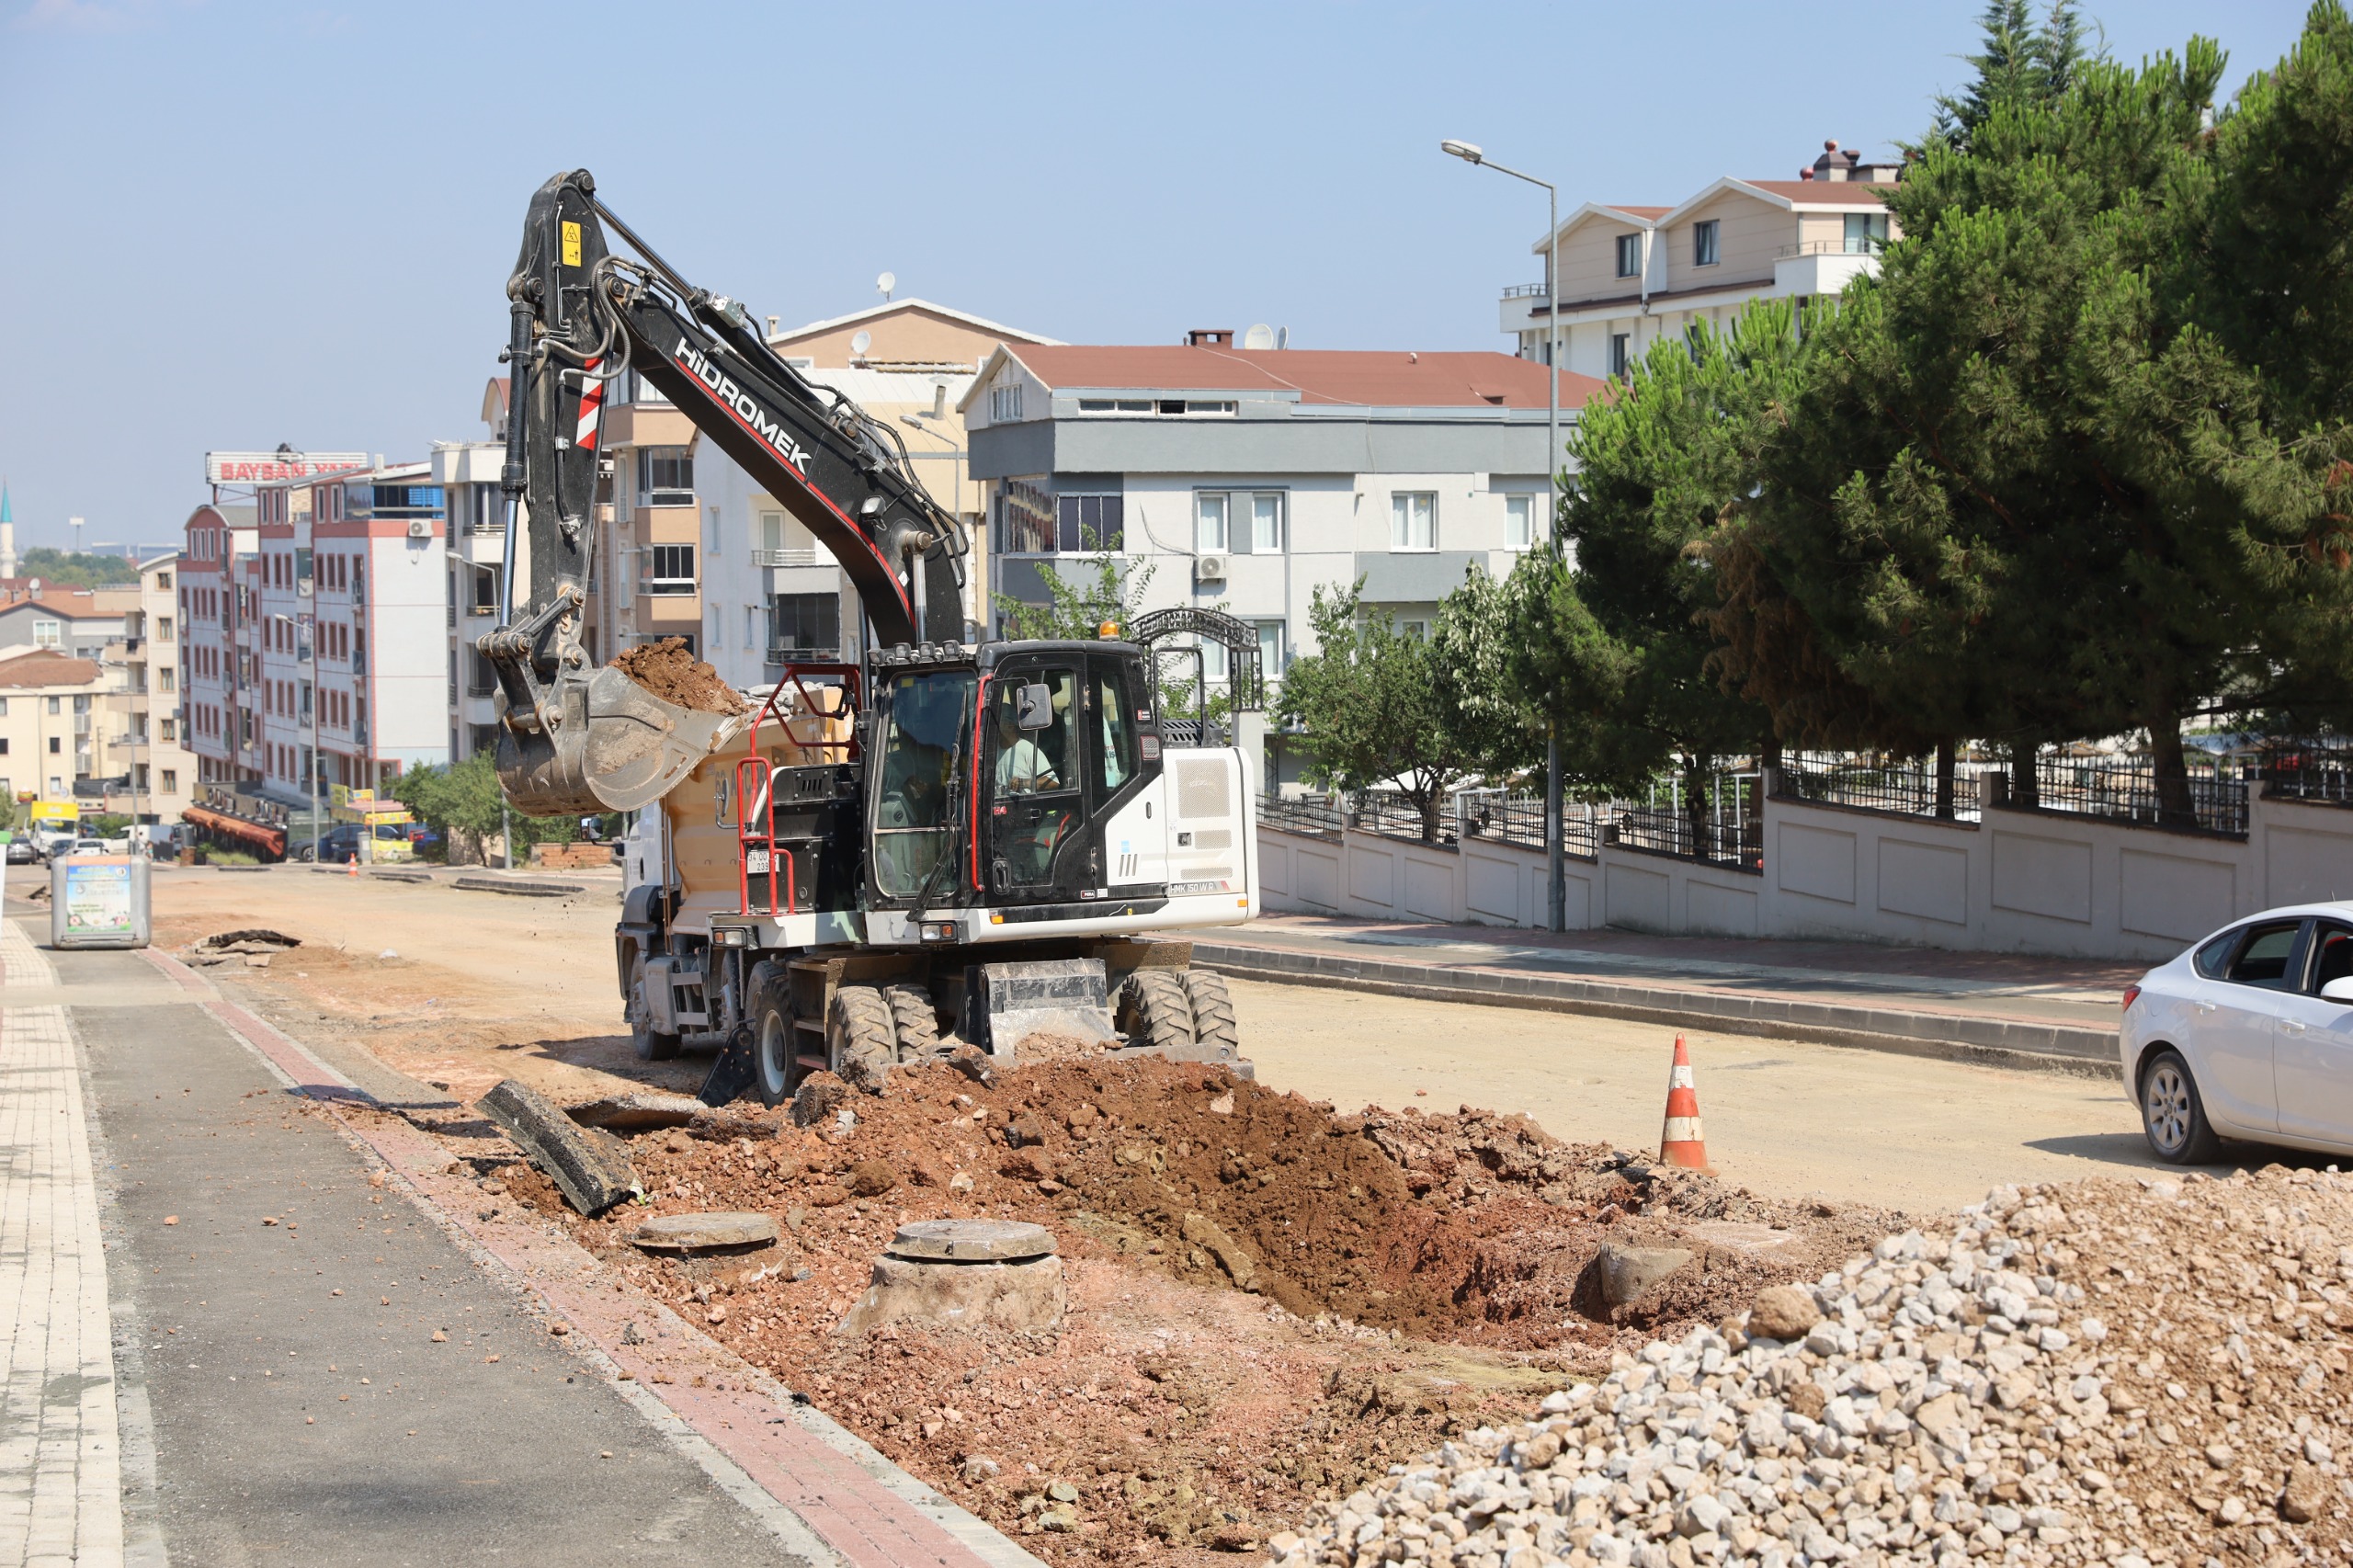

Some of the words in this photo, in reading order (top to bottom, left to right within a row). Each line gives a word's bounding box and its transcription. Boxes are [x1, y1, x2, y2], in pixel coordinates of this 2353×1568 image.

[221, 462, 306, 480] BAYSAN
[1170, 884, 1186, 894] HMK
[1187, 883, 1199, 893] 150
